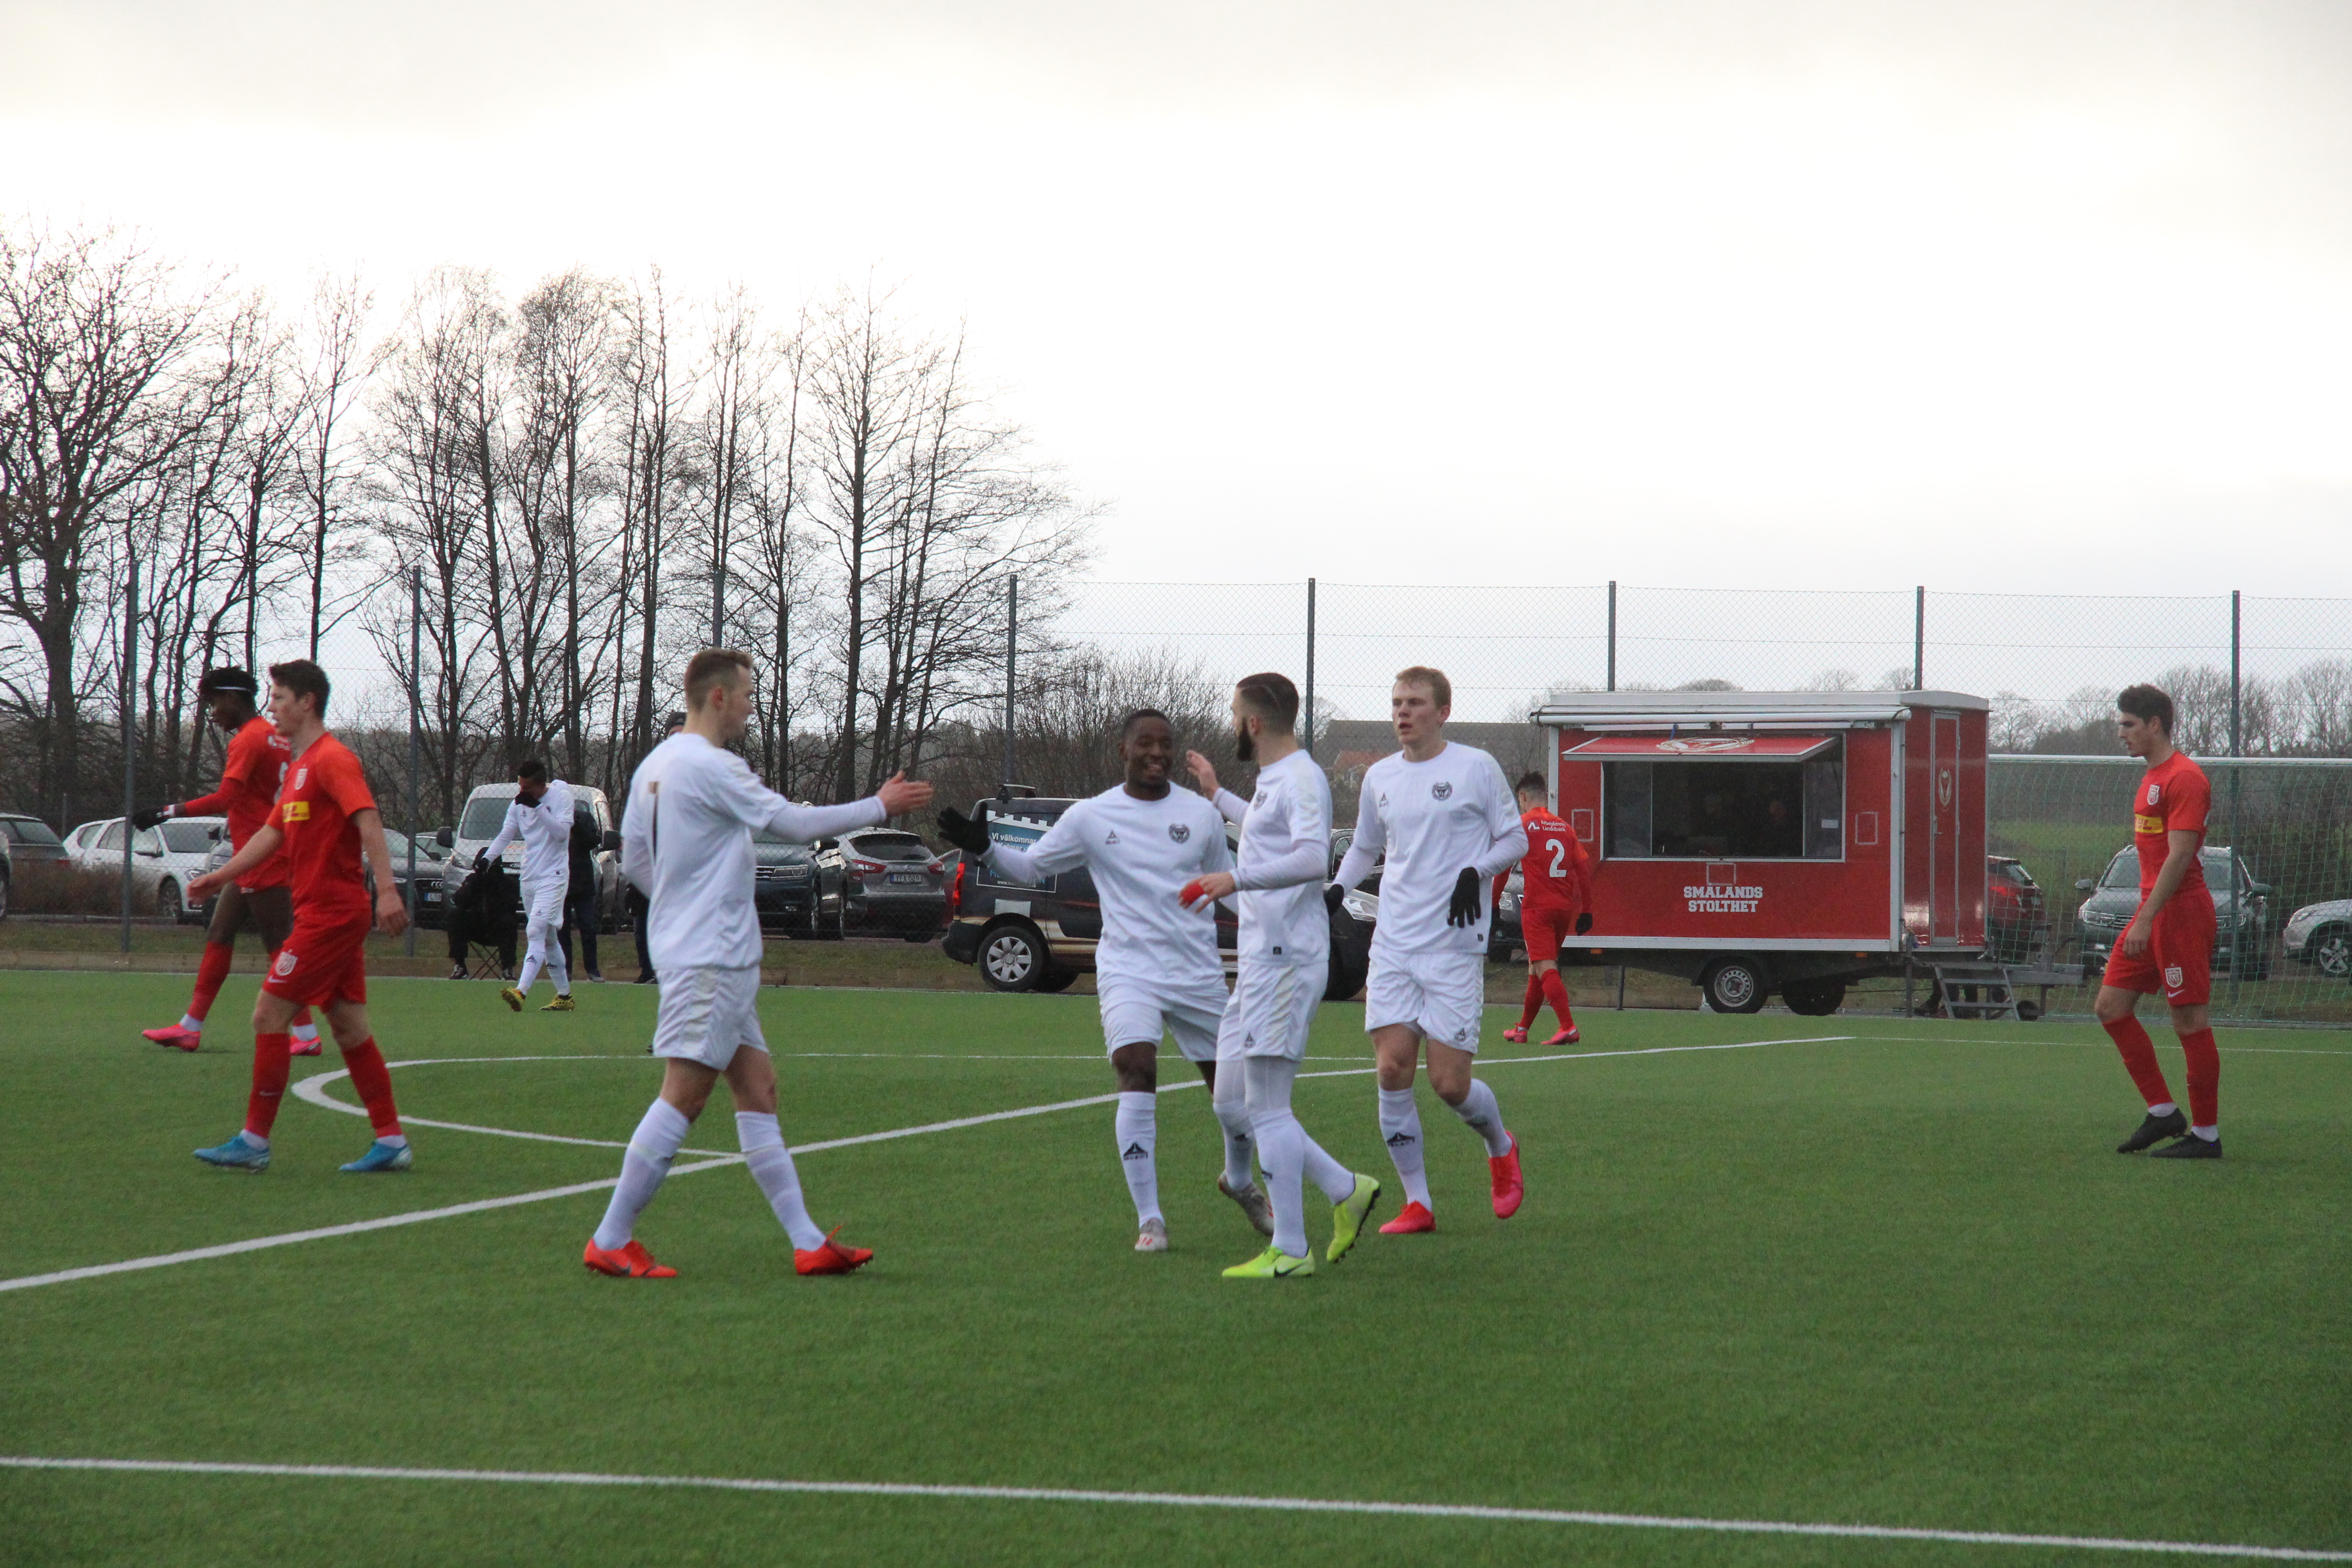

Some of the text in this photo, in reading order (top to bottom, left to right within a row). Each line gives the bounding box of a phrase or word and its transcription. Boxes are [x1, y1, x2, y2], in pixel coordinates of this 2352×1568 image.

[992, 832, 1036, 844] Vi välkomnar
[1545, 838, 1567, 877] 2
[1688, 900, 1759, 912] STOLTHET
